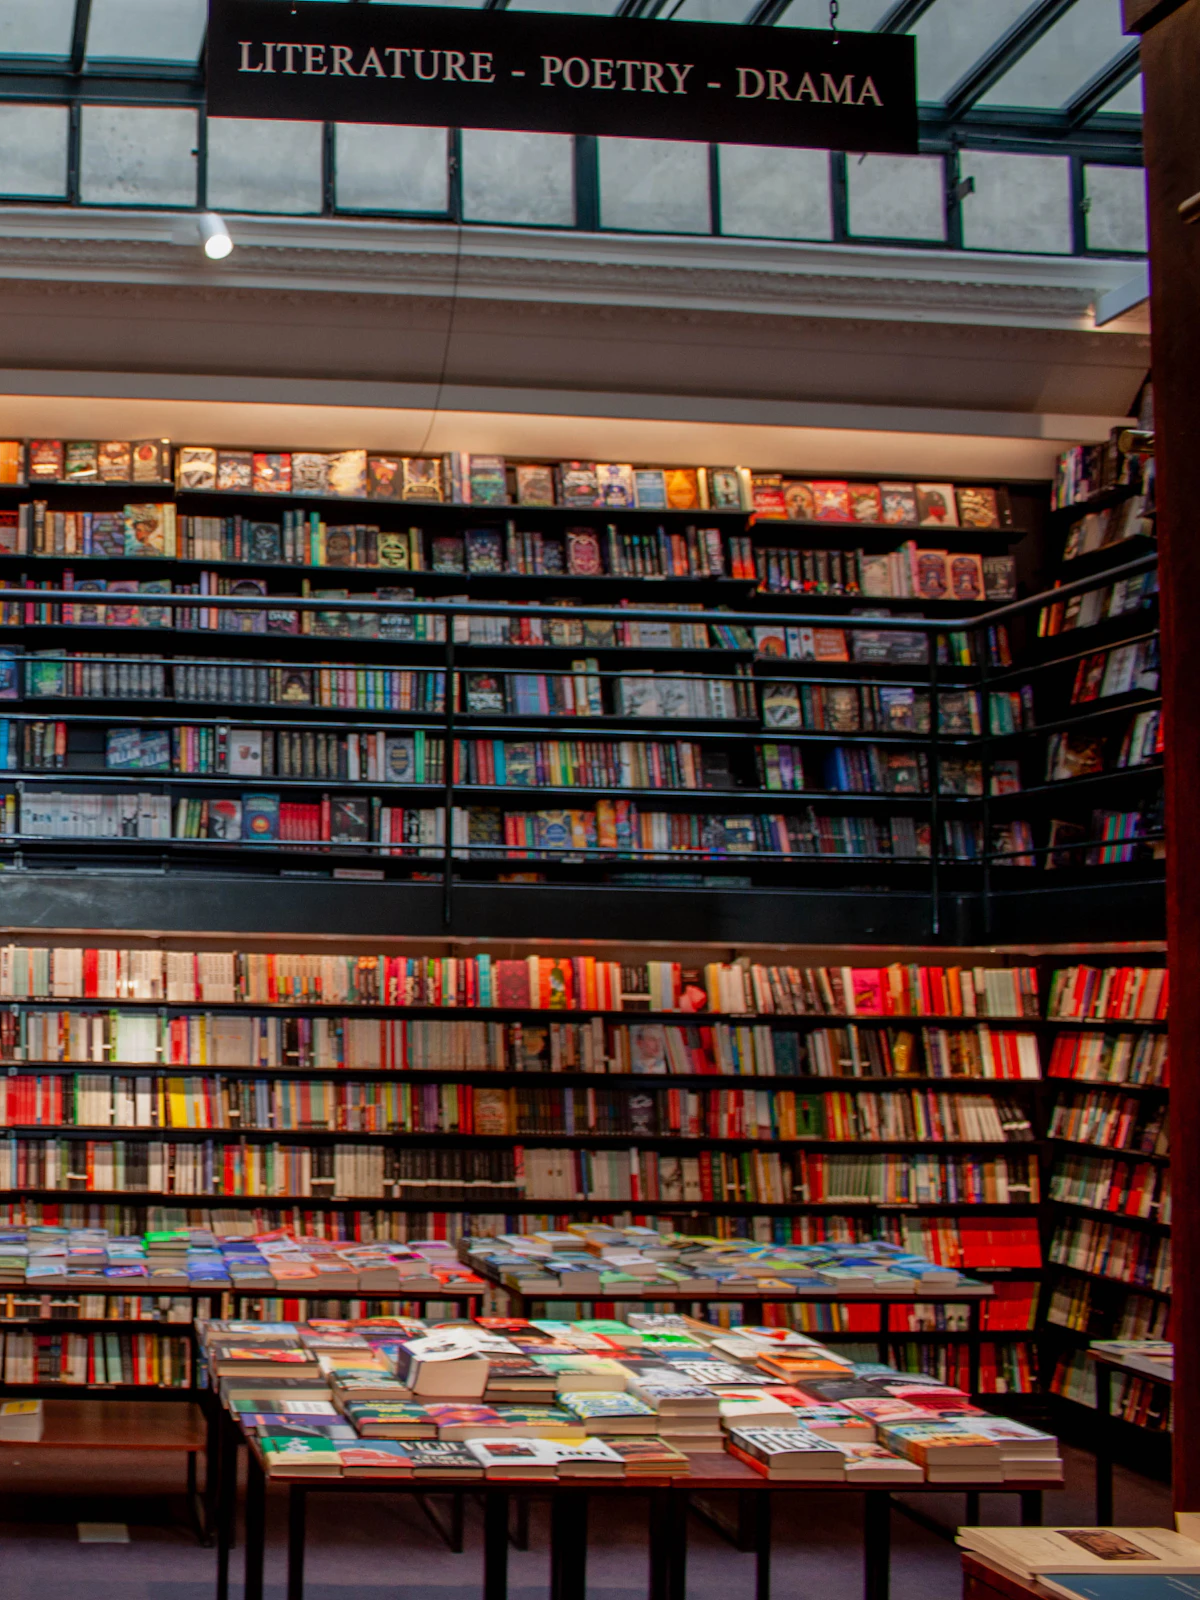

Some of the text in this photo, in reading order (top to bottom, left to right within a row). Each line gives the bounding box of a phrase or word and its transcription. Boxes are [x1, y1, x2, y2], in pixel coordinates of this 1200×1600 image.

[237, 41, 495, 83] LITERATURE
[540, 55, 694, 96] POETRY
[735, 66, 884, 107] DRAMA
[400, 1441, 467, 1452] VIGIL
[746, 1432, 843, 1452] FLESH
